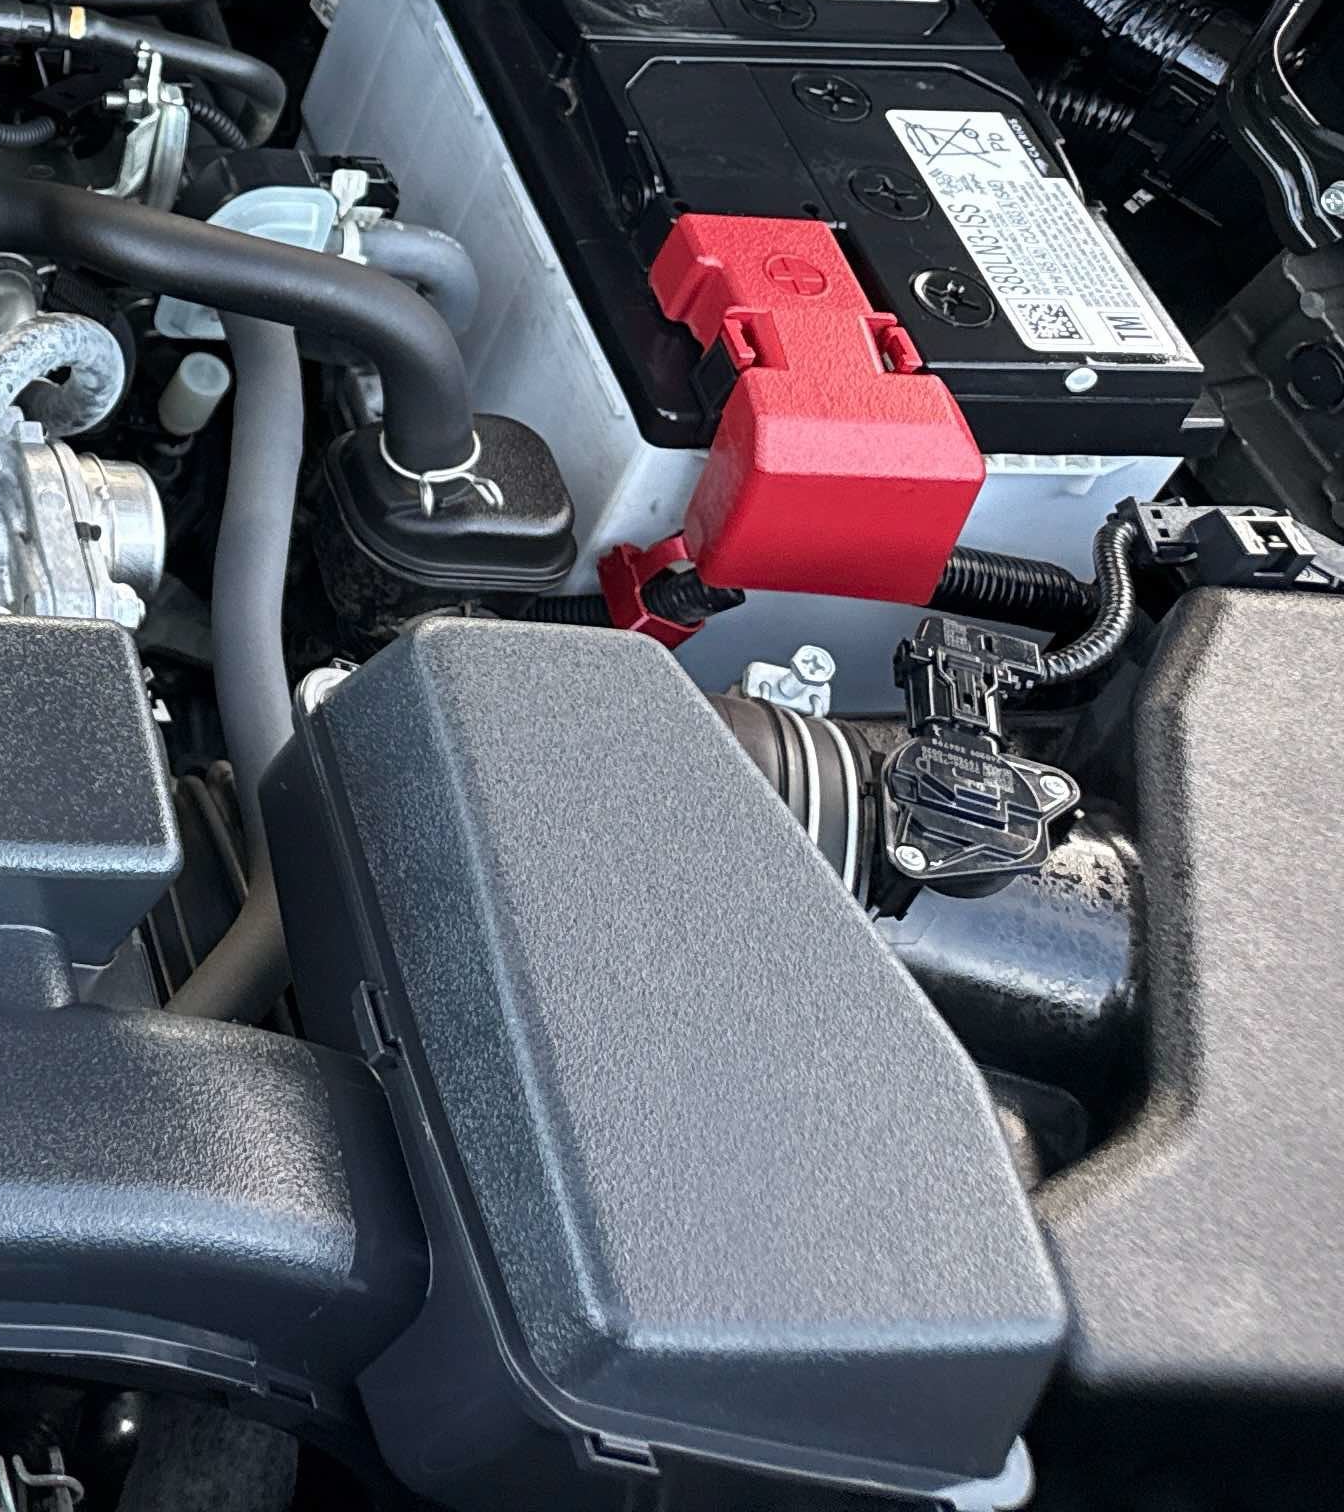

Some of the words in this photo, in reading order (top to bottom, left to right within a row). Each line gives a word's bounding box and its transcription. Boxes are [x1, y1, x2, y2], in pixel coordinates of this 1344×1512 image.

[985, 132, 1011, 152] Pb
[1007, 117, 1040, 158] CLARIOS
[947, 203, 1032, 295] 380LN3-ISS
[1107, 316, 1153, 341] TM
